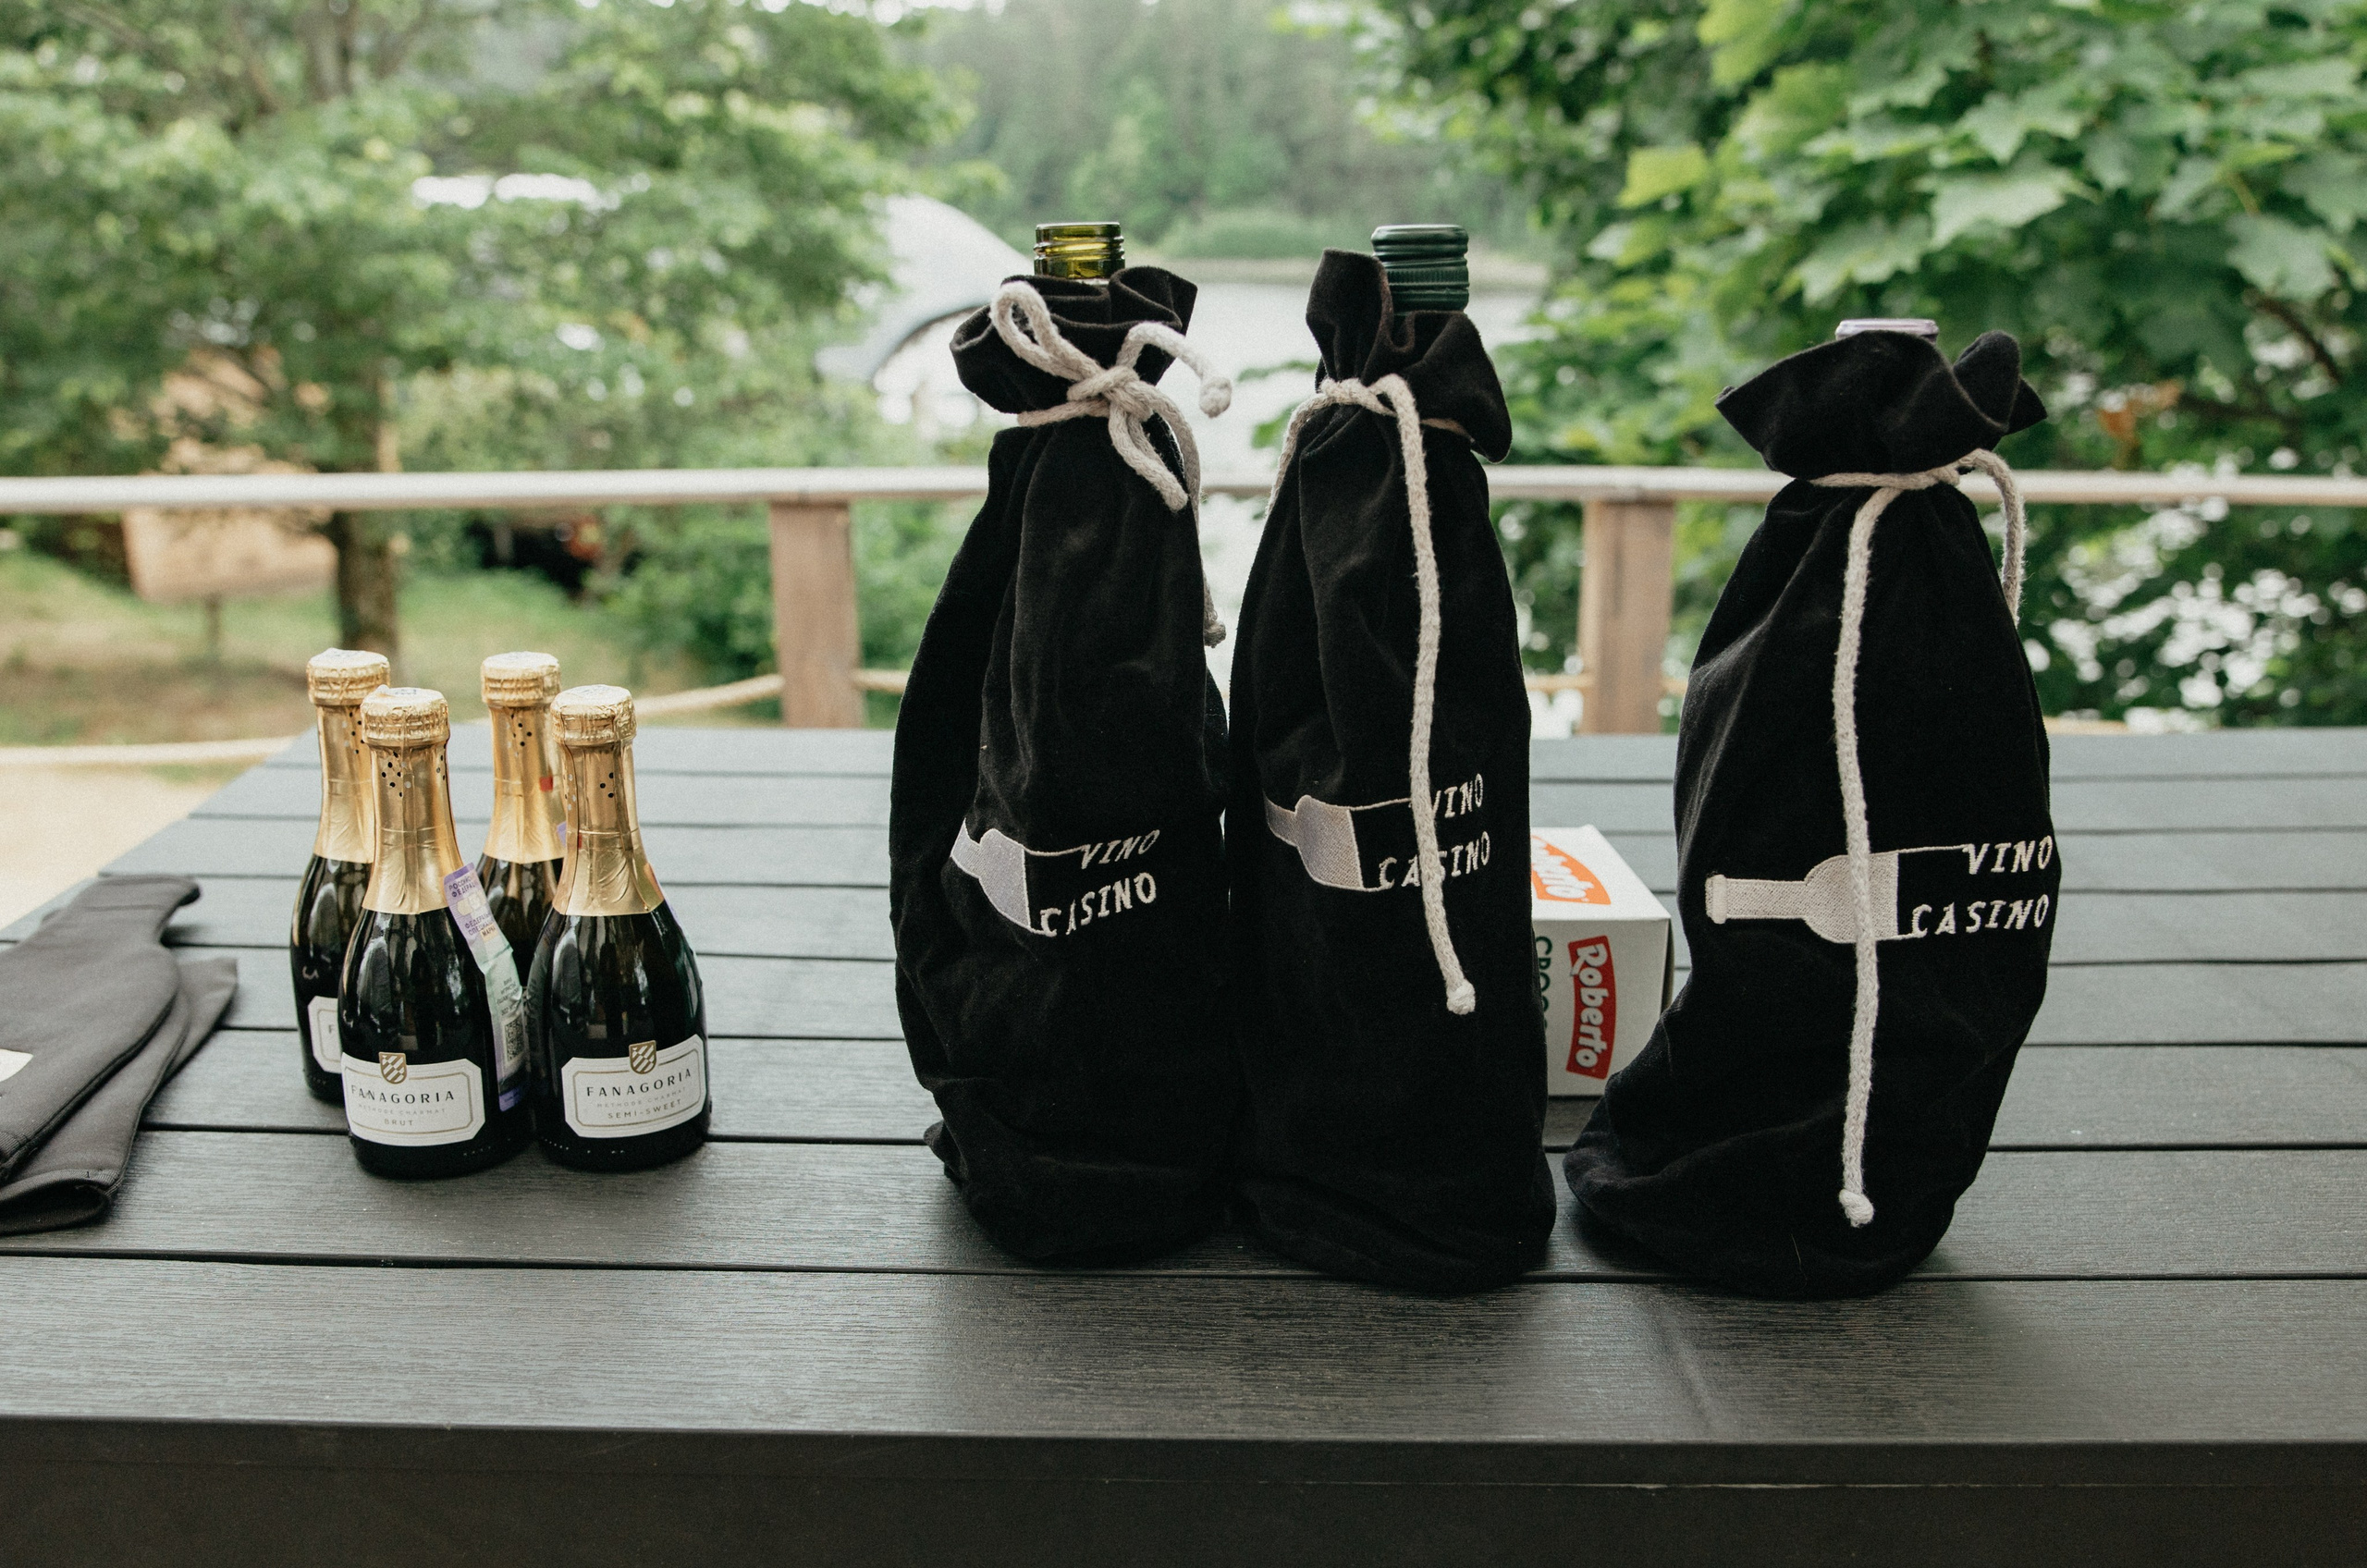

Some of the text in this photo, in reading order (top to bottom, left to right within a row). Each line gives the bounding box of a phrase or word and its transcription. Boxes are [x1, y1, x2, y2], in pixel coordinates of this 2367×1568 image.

[1080, 829, 1160, 870] VINO
[1962, 835, 2054, 876] VINO
[1039, 872, 1157, 937] CASINO
[1911, 894, 2050, 937] CASINO
[1570, 942, 1609, 1069] Roberto
[350, 1084, 455, 1104] FANAGORIA
[586, 1068, 692, 1097] FANAGORIA
[384, 1118, 413, 1126] BRUT
[607, 1098, 682, 1120] SEMI-SWEET
